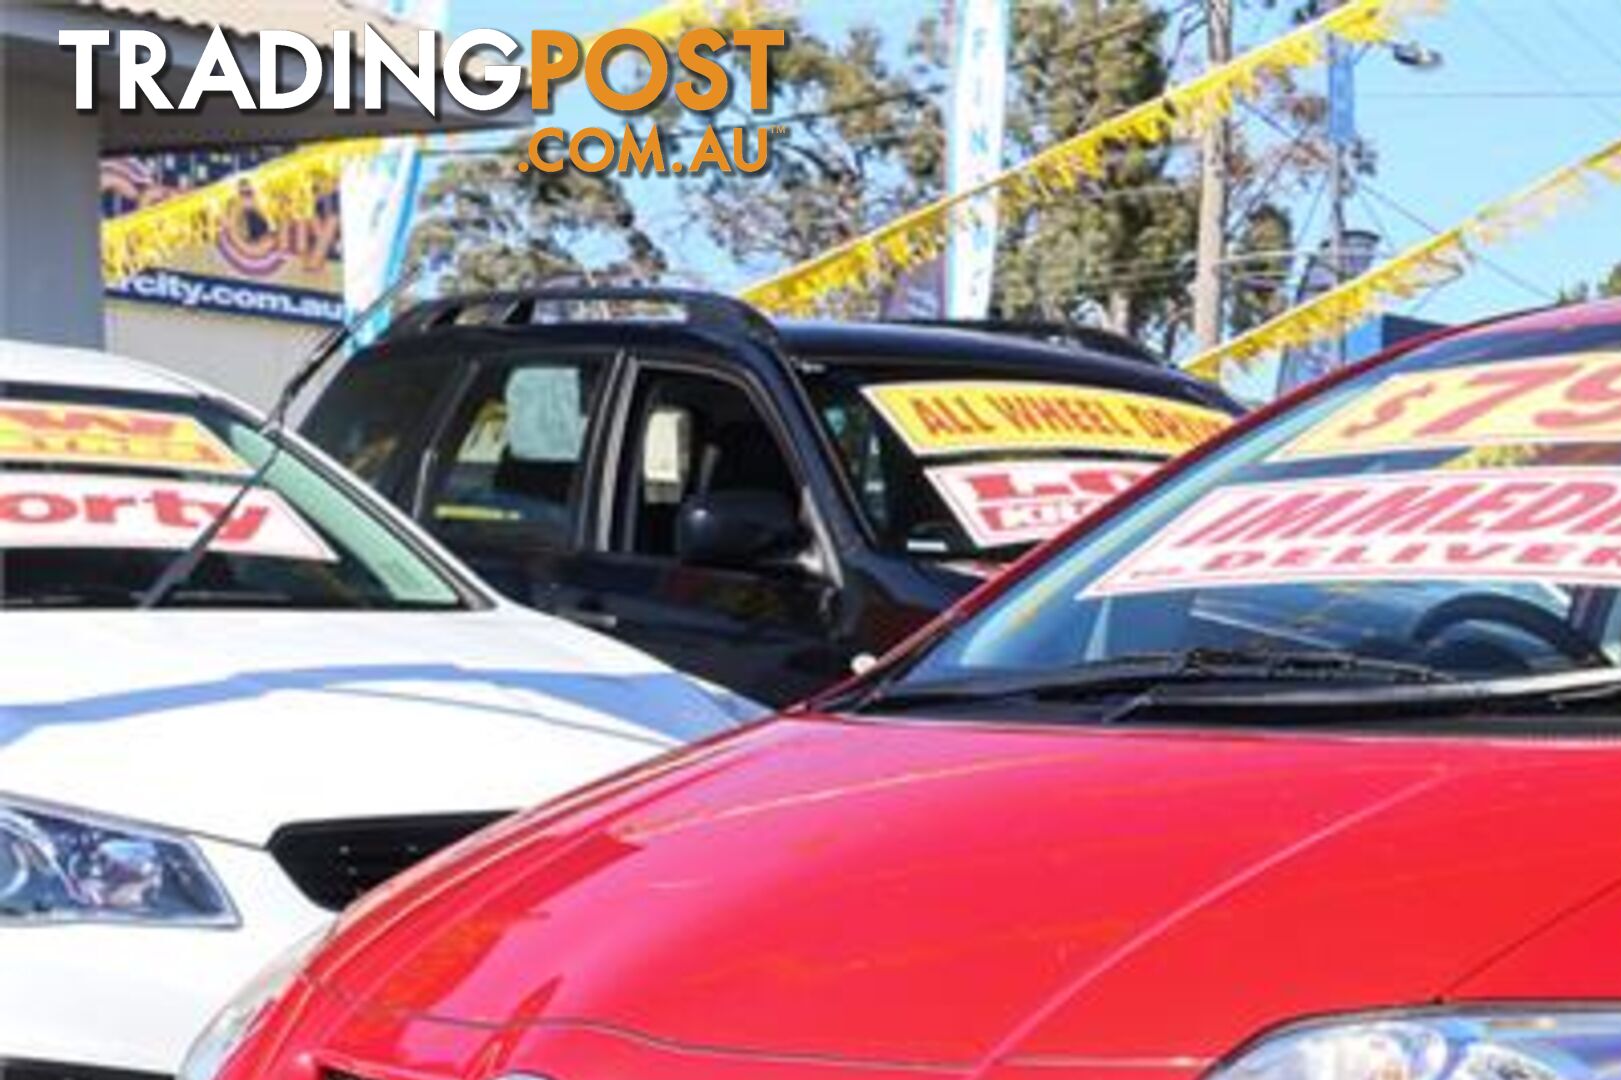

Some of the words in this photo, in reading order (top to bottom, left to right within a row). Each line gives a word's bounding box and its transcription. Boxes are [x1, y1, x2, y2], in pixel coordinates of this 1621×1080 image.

[117, 270, 346, 322] rcity.com.au
[913, 398, 994, 438] ALL
[985, 398, 1135, 437] WHEEL
